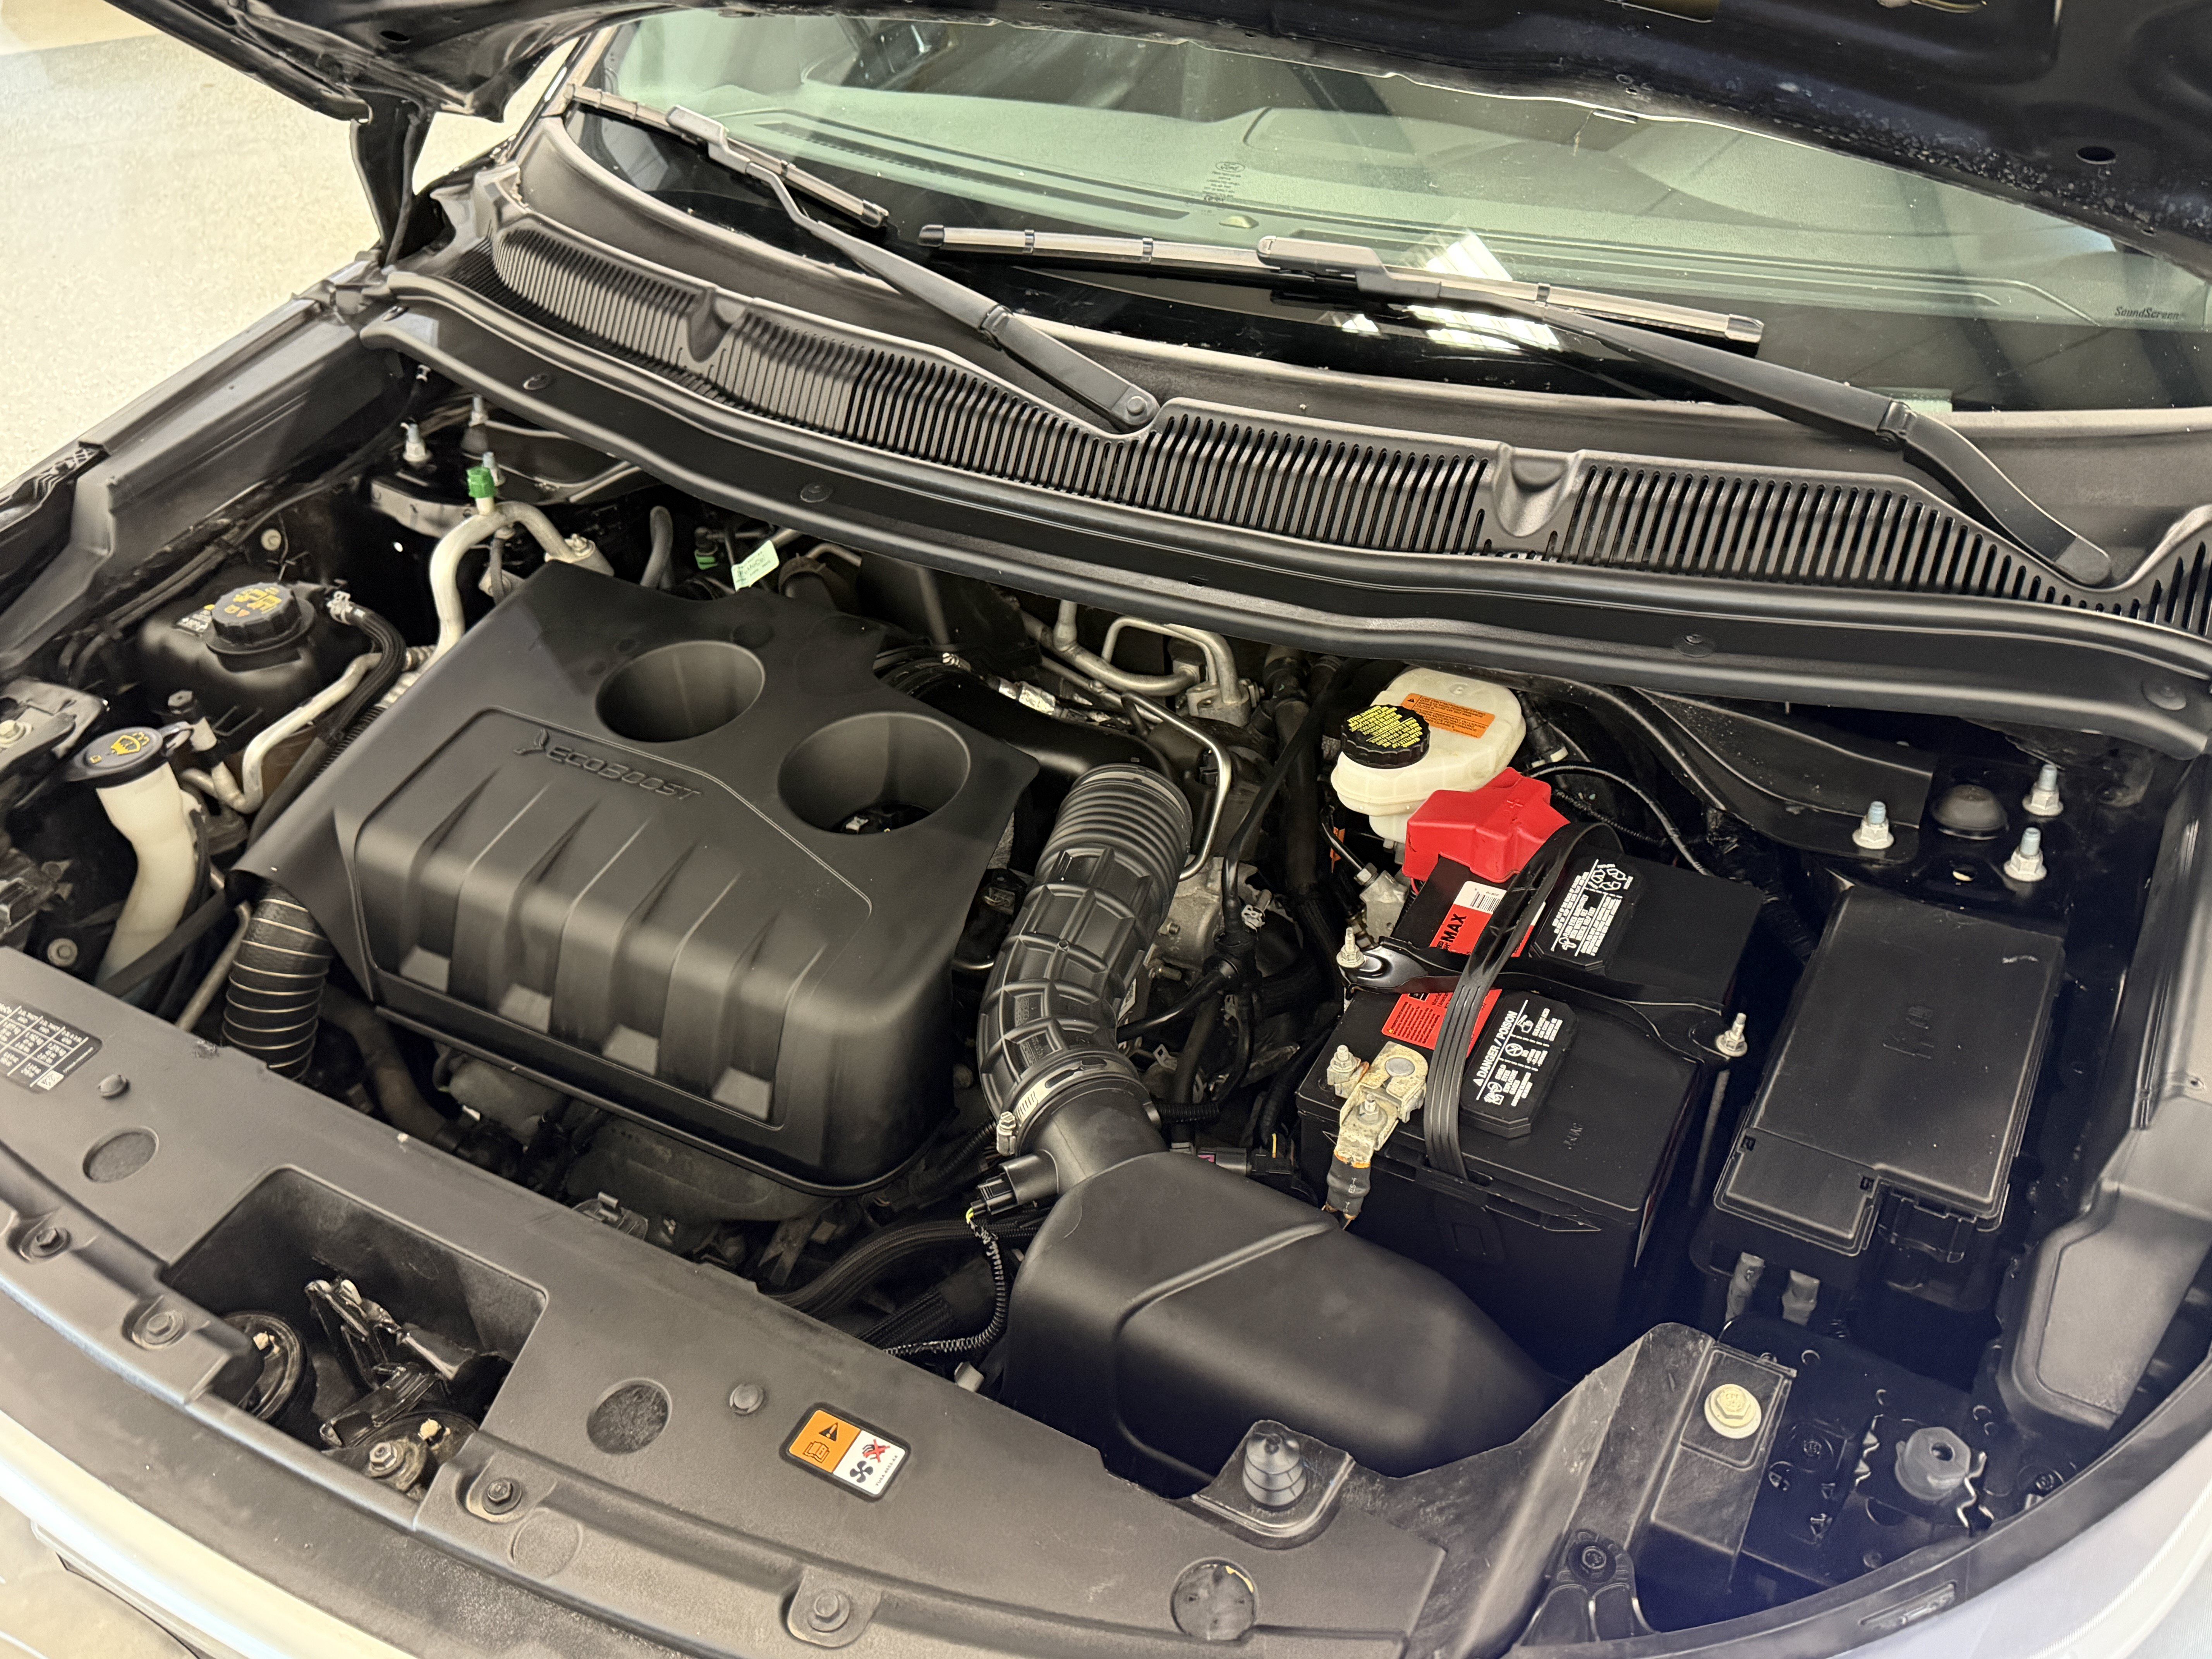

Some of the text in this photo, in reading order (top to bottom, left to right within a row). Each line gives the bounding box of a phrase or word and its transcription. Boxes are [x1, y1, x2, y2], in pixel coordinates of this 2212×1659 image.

[2114, 306, 2180, 320] SoundScreen
[546, 745, 702, 800] ECOBOOST
[1440, 913, 1467, 943] MAX
[1479, 1044, 1500, 1079] DANGER
[1499, 1010, 1518, 1040] POISON
